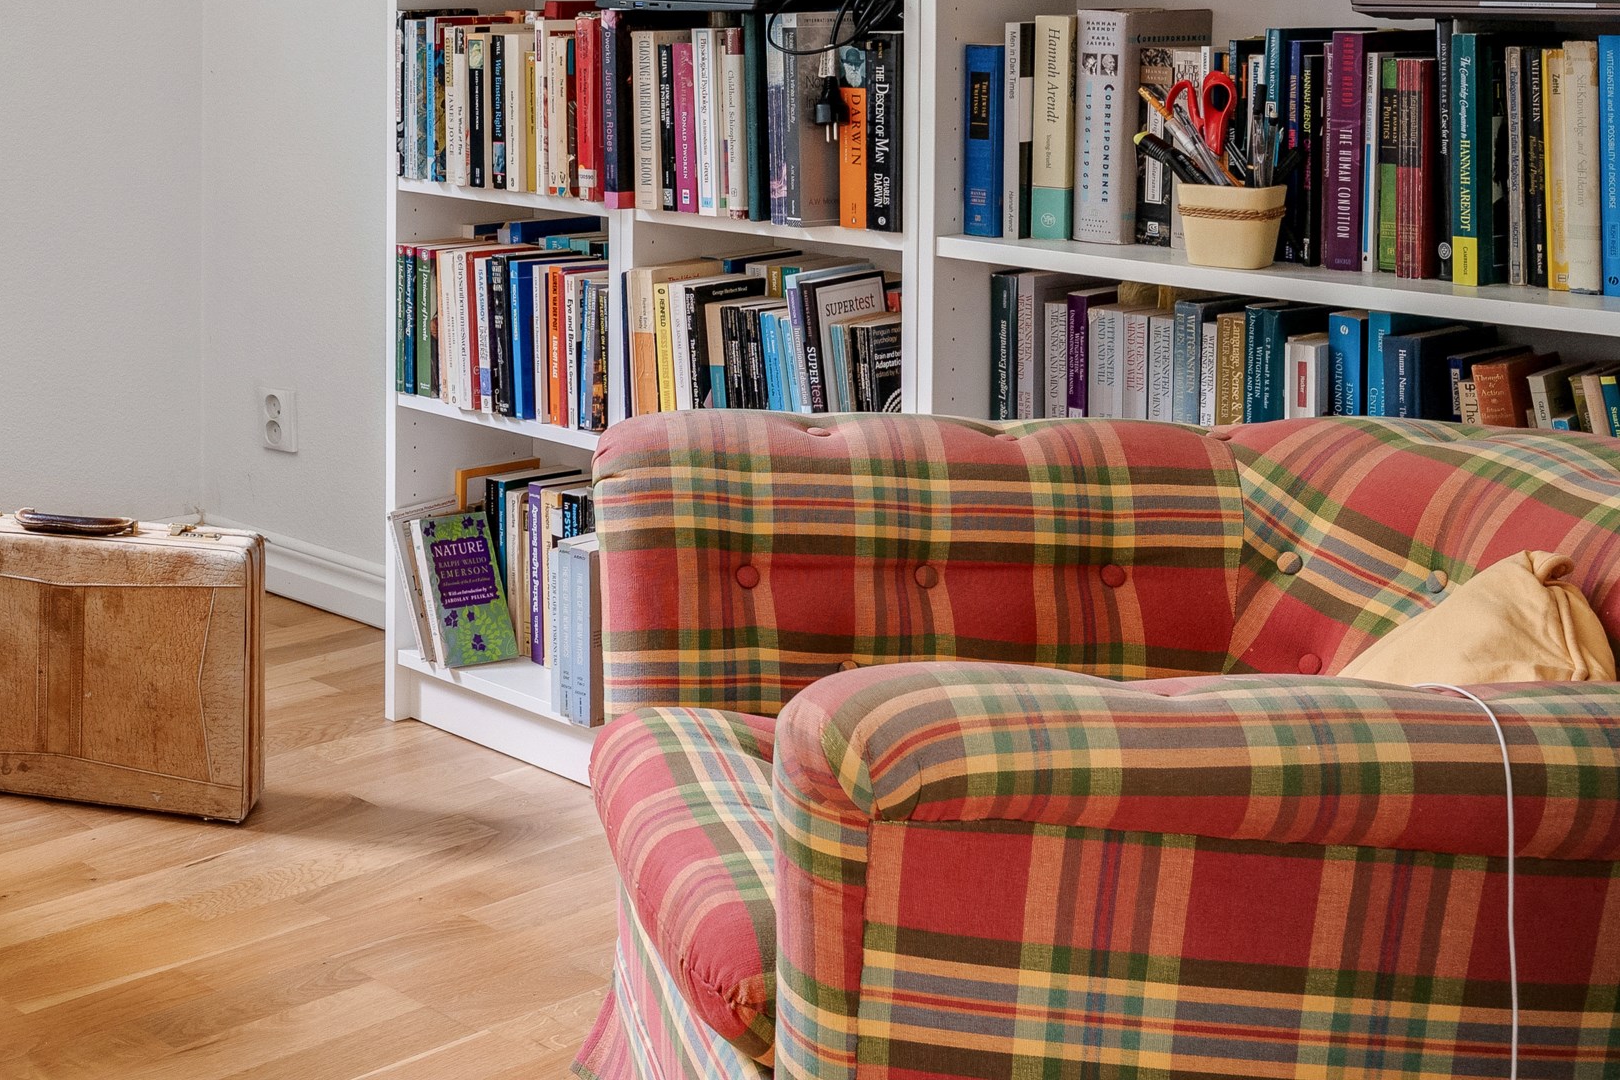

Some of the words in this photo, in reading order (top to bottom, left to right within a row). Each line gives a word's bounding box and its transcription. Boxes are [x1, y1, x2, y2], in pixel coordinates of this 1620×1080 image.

[639, 41, 650, 77] CLOSING
[1048, 27, 1060, 75] Hannah
[875, 65, 883, 83] THE
[1532, 60, 1541, 122] WITTGENSTEIN
[1551, 73, 1560, 95] Zettel
[606, 109, 611, 119] in
[640, 82, 651, 125] AMERICAN
[875, 85, 889, 123] DESCENT
[1047, 81, 1059, 124] Arendt
[1303, 102, 1311, 134] ARENDT
[641, 127, 651, 151] MIND
[852, 94, 861, 166] DARWIN
[876, 124, 883, 137] OF
[1082, 93, 1091, 190] 1926-1969
[1101, 83, 1115, 203] CORRESPONDENCE
[1339, 129, 1352, 145] THE
[876, 139, 889, 163] MAN
[1339, 149, 1352, 182] HUMAN
[1459, 139, 1471, 179] HANNAH
[641, 158, 651, 186] BLOOM
[874, 173, 883, 208] DARWIN
[1459, 180, 1471, 232] ARENDT
[1338, 186, 1350, 239] CONDITION
[825, 294, 875, 316] SUPERtest
[794, 328, 805, 373] International
[999, 320, 1007, 363] Excavations
[1136, 323, 1144, 392] WITTGENSTEIN
[1230, 320, 1243, 367] Language,
[807, 347, 823, 408] SUPERtest
[1399, 349, 1407, 376] Human
[799, 372, 807, 405] Education
[998, 364, 1008, 400] Logical
[1232, 370, 1243, 401] Sense
[1452, 371, 1460, 411] STRAWSON
[434, 541, 484, 557] NATURE
[438, 560, 460, 568] RALPH
[462, 557, 487, 565] WALDO
[440, 566, 488, 578] EMERSON
[445, 596, 469, 604] JAROSLAV
[471, 593, 494, 601] PELIKAN
